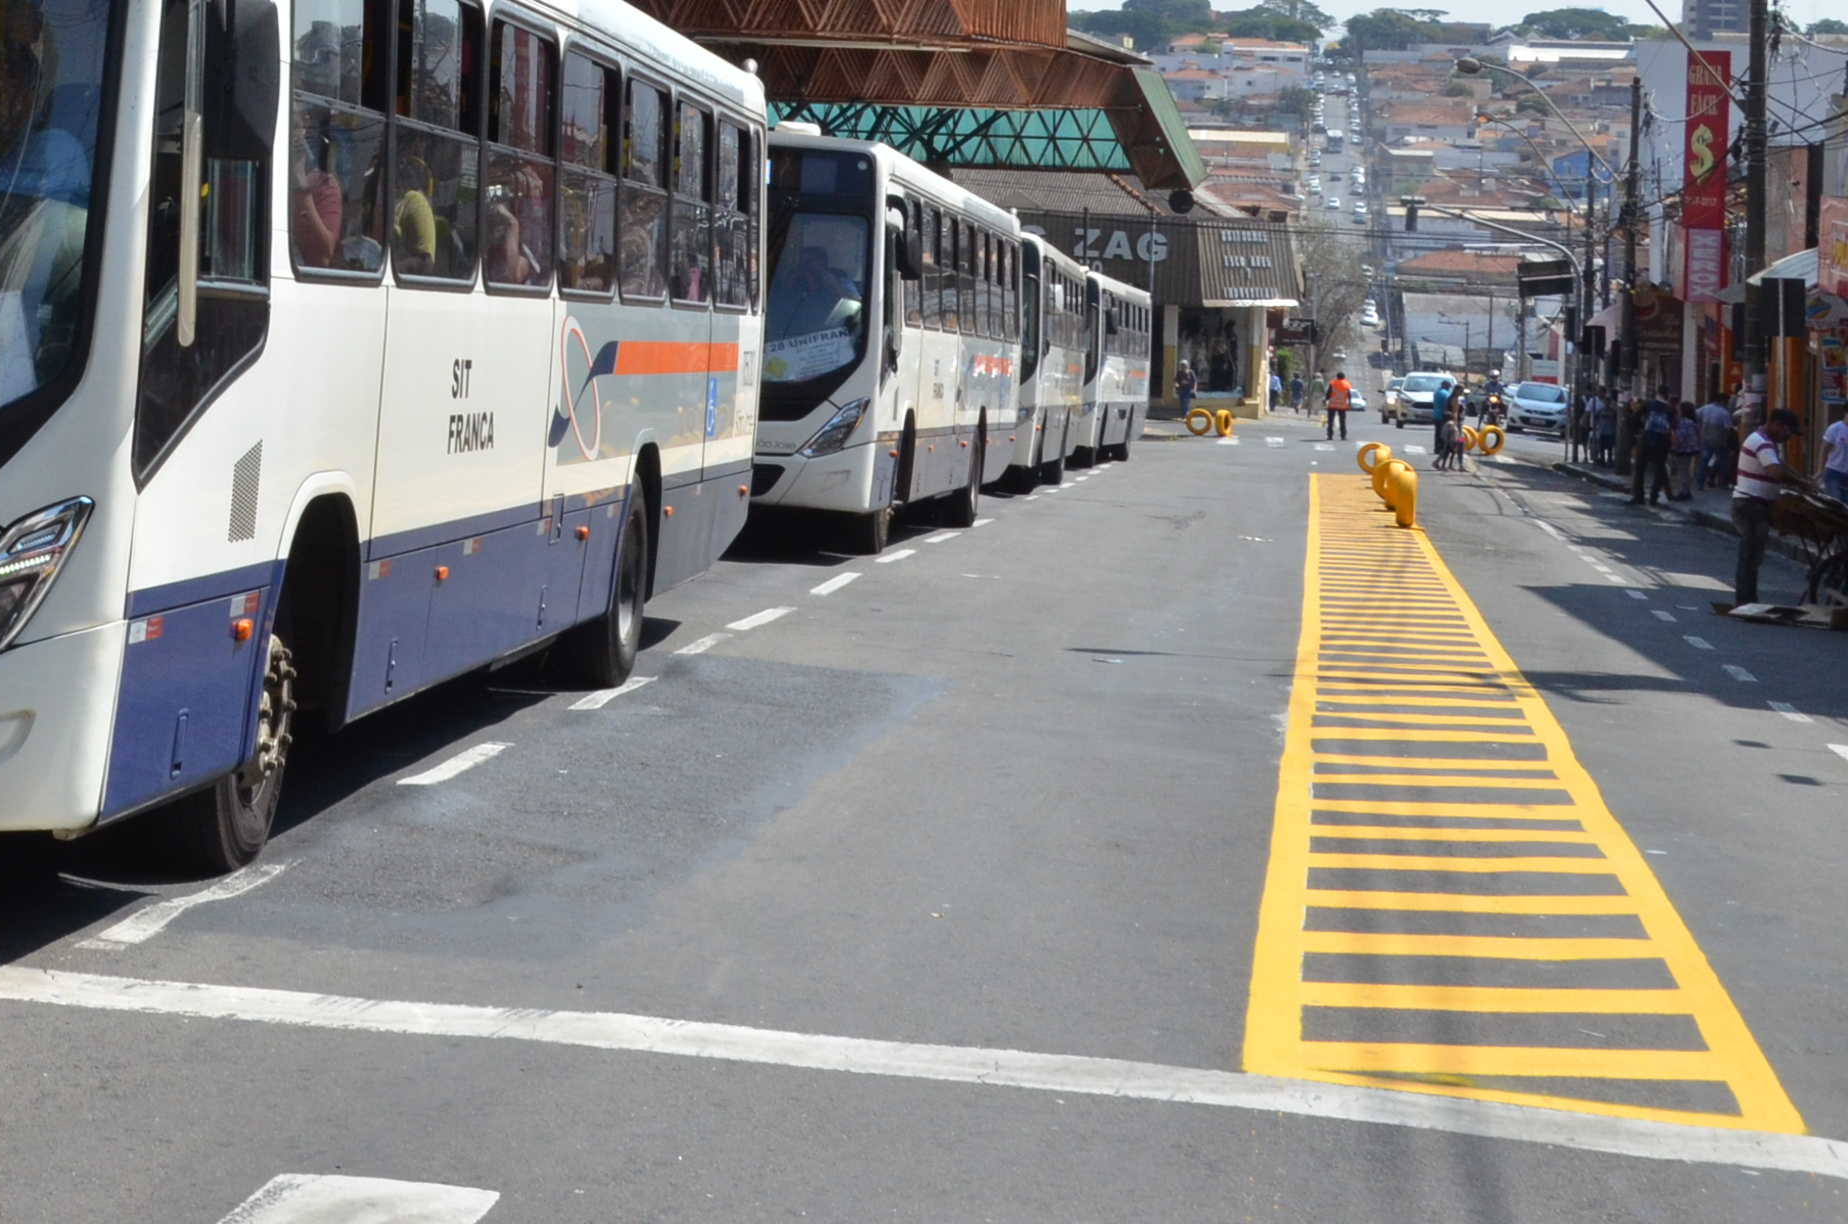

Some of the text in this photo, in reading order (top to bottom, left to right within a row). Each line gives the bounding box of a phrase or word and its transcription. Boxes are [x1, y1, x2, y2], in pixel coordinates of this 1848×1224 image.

[1690, 90, 1719, 115] FÁCIL
[1073, 228, 1168, 262] ZAG
[1690, 235, 1719, 297] XEROX
[769, 329, 848, 352] 28 UNIFRAN
[451, 358, 472, 399] SIT
[447, 411, 494, 455] FRANCA
